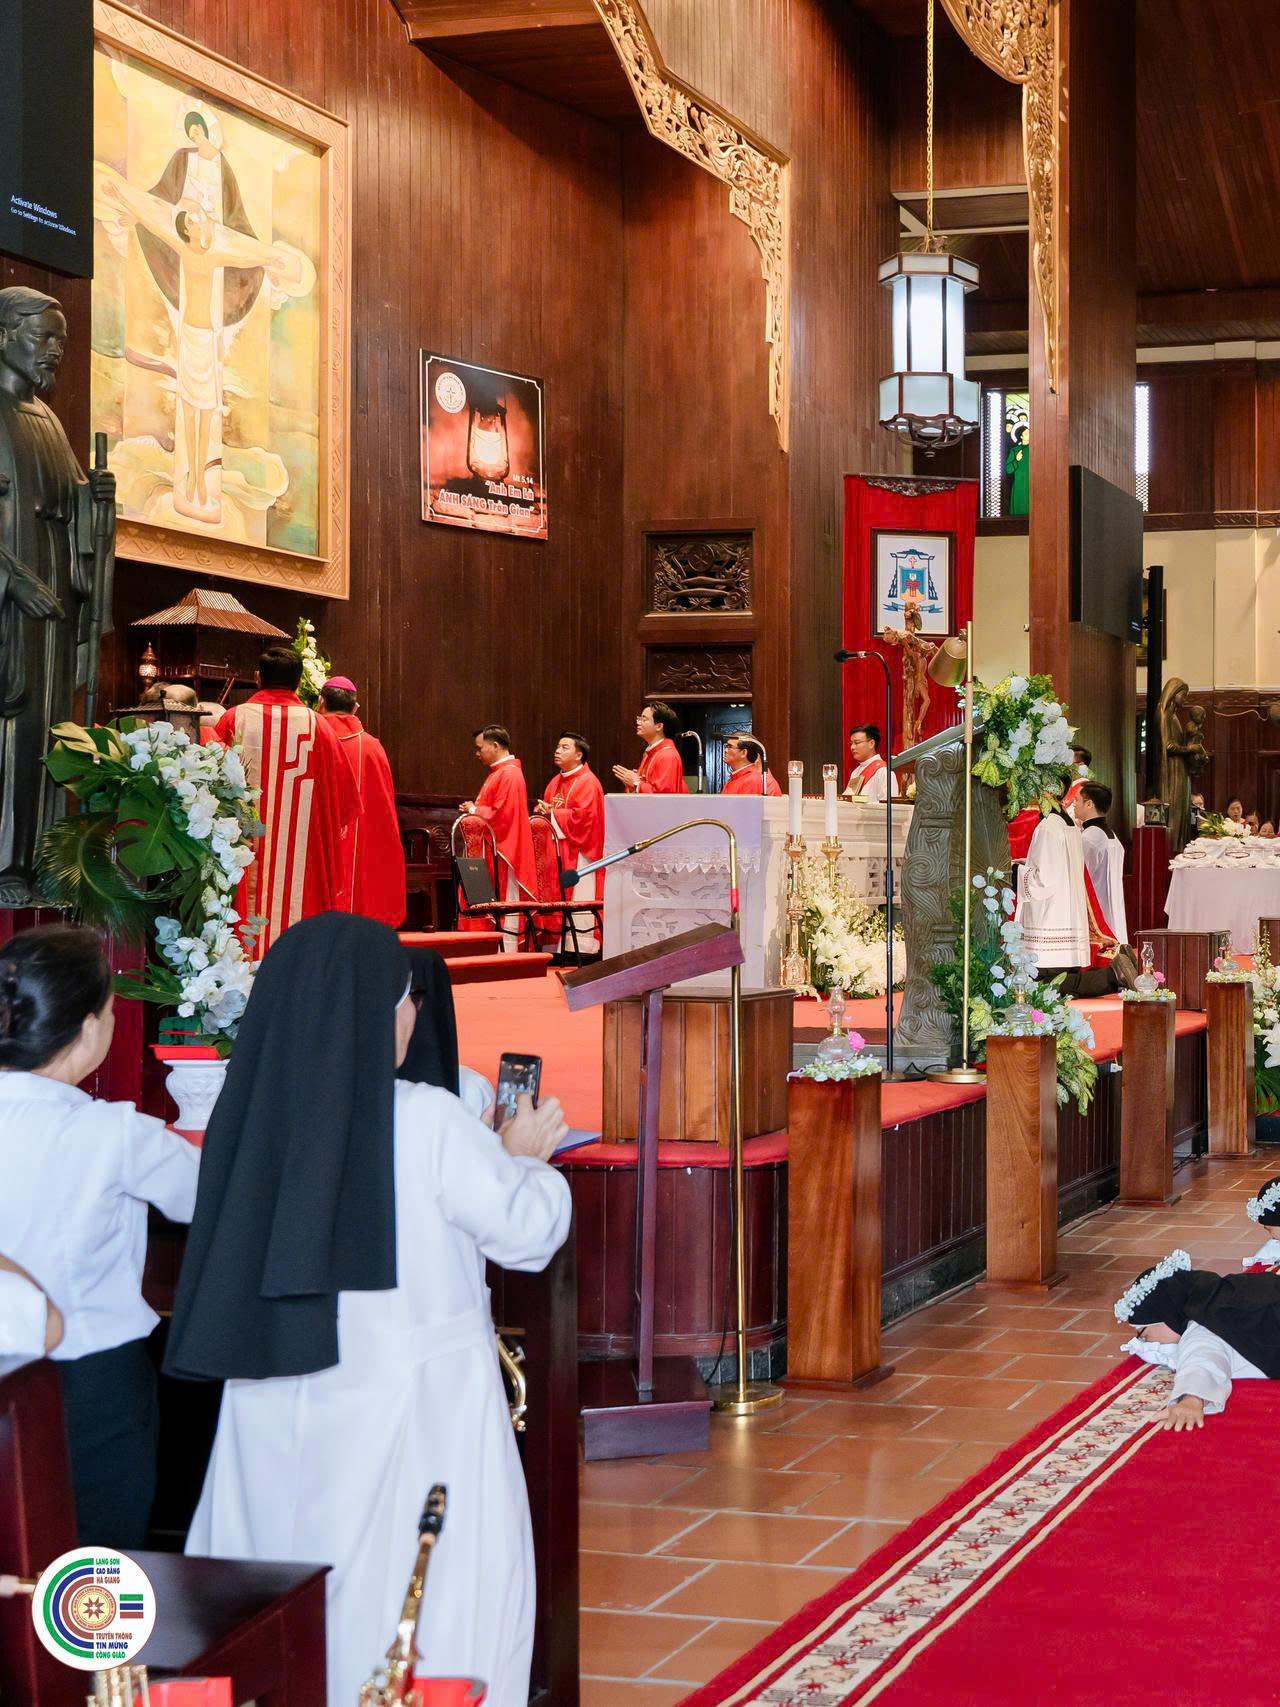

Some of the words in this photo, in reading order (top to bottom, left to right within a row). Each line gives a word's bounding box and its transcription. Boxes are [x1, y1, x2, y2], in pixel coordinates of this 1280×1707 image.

[11, 194, 33, 210] Activate
[33, 203, 58, 219] Windows
[461, 493, 487, 509] SÁNG
[507, 484, 522, 499] Em
[522, 487, 535, 501] Là
